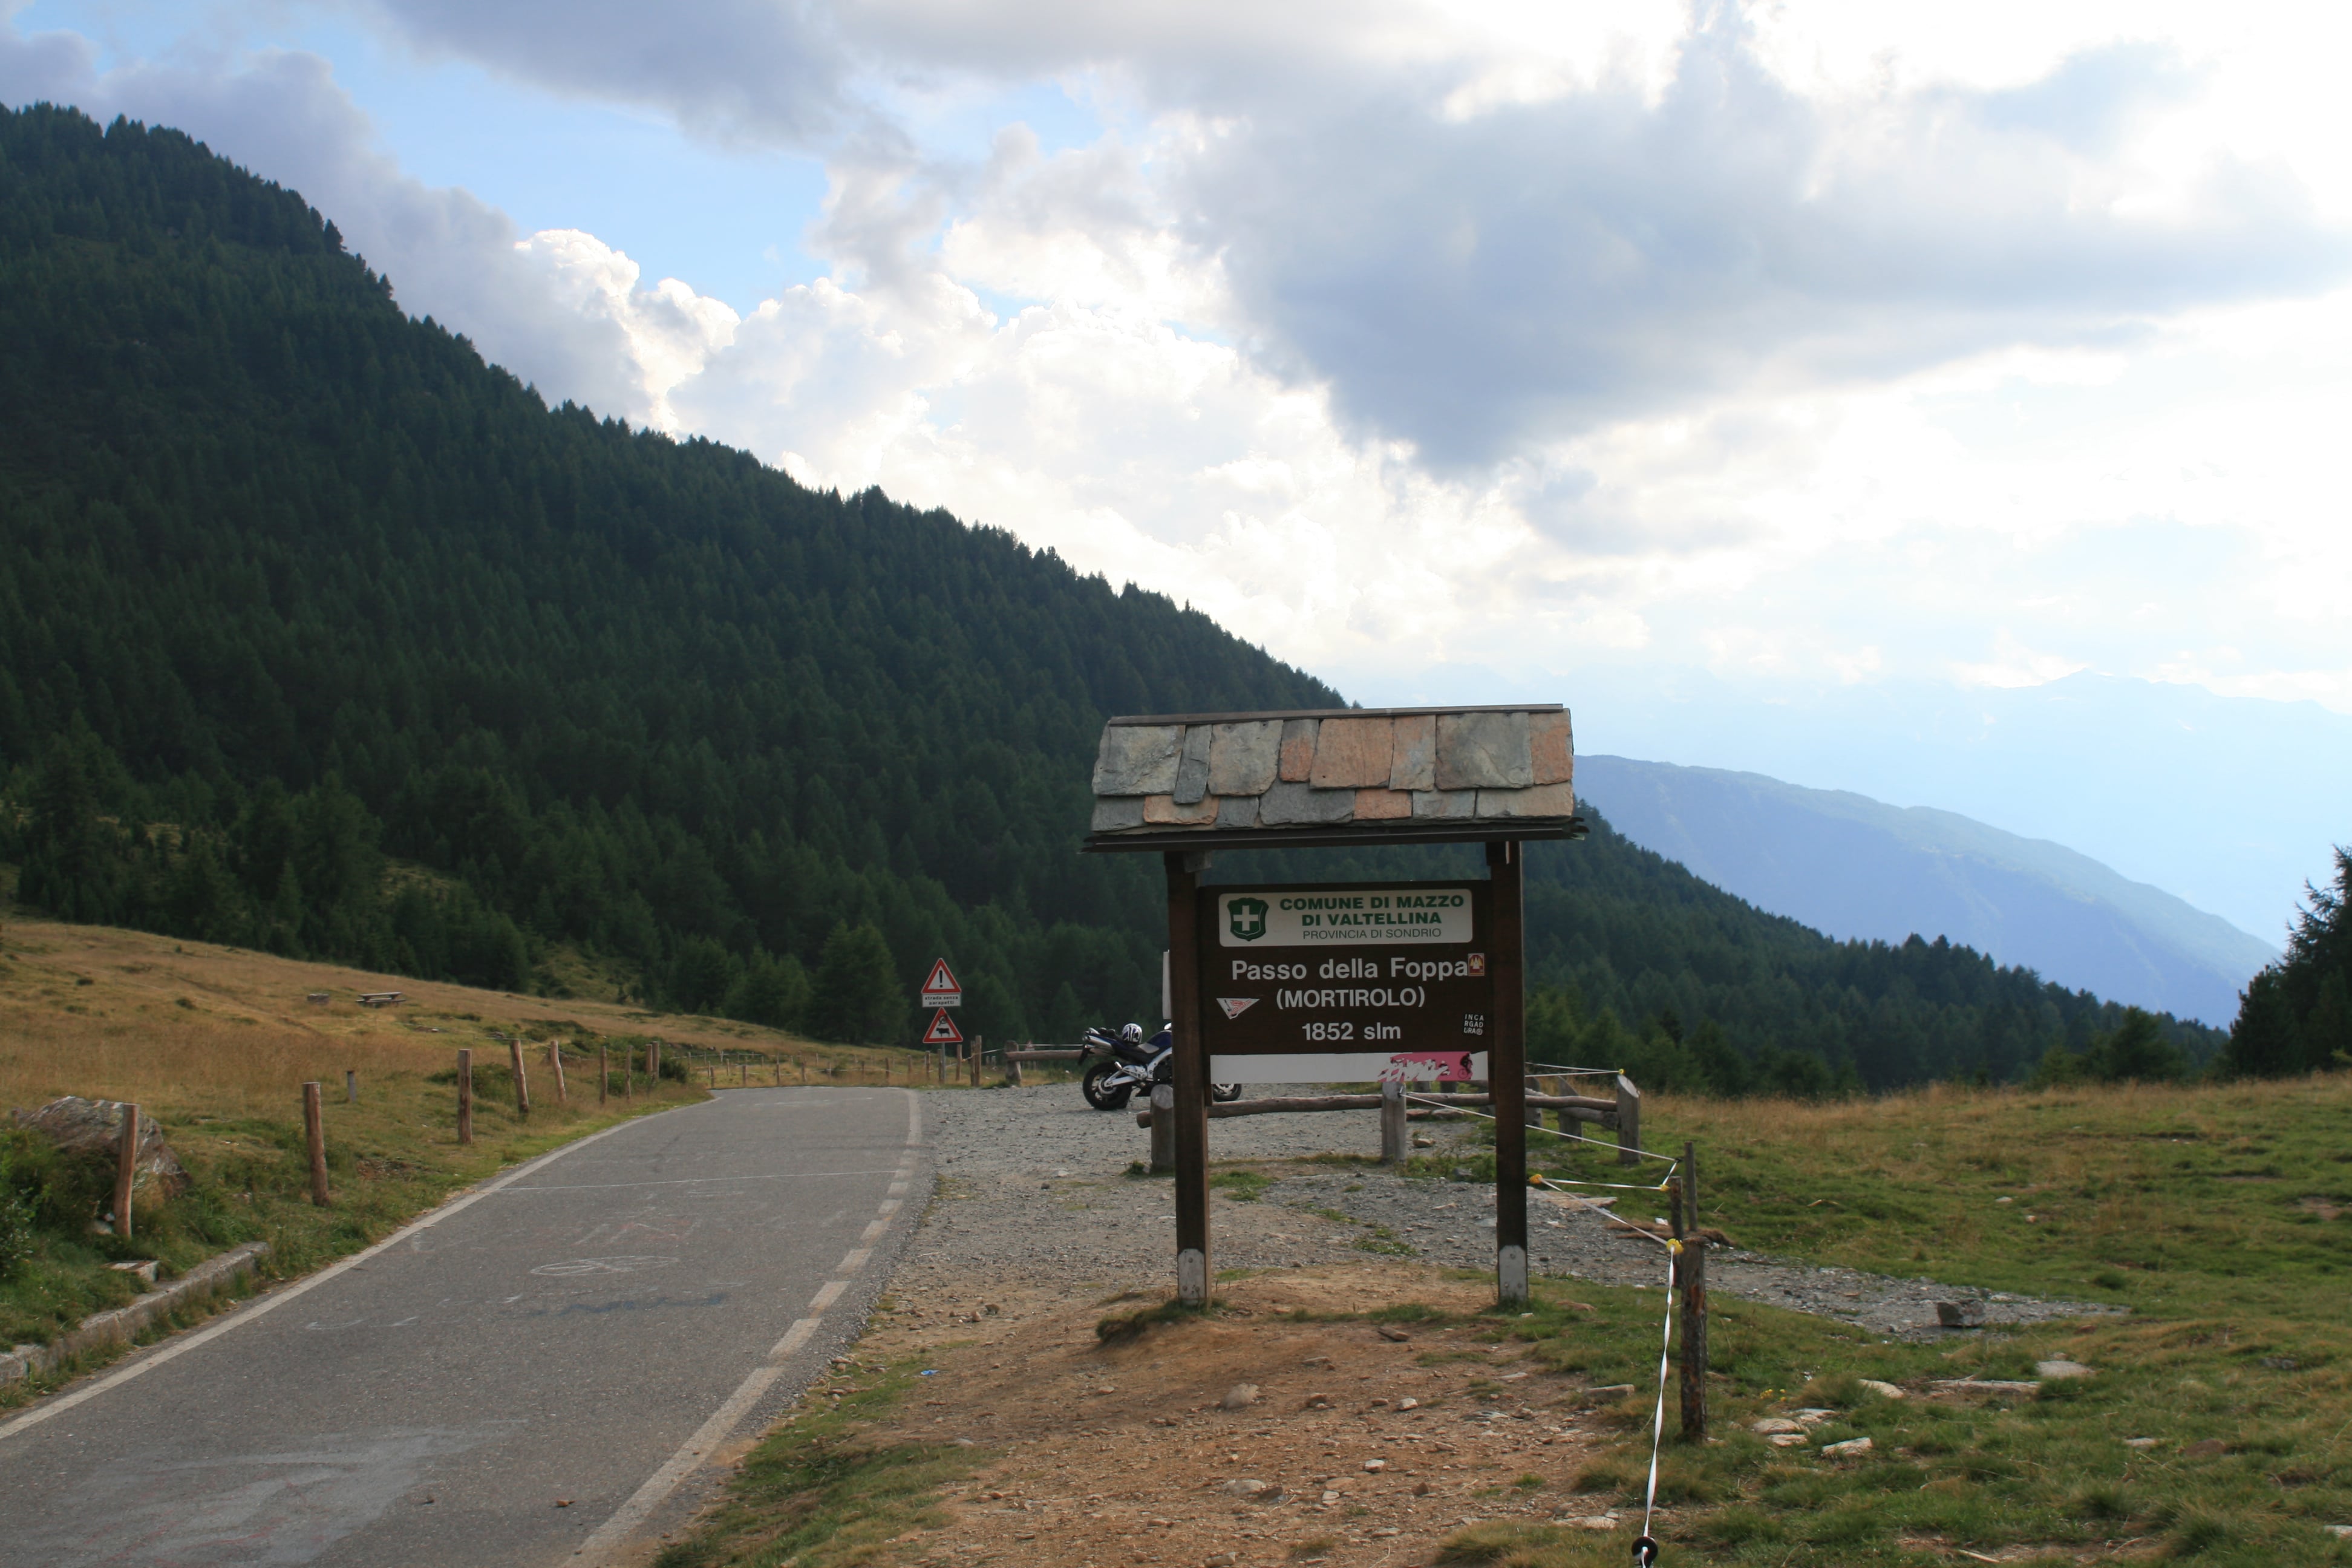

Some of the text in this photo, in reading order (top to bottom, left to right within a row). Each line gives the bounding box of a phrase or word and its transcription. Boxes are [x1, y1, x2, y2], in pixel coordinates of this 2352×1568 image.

[1279, 895, 1464, 910] COMUNE DI MAZZO
[1302, 912, 1442, 926] DI VALTELLINA
[1303, 928, 1442, 939] PROVINCIA DI SONDRIO
[1232, 957, 1468, 981] Passo della Foppa
[1276, 987, 1425, 1010] (MORTIROLO)
[1302, 1022, 1401, 1040] 1852 slm
